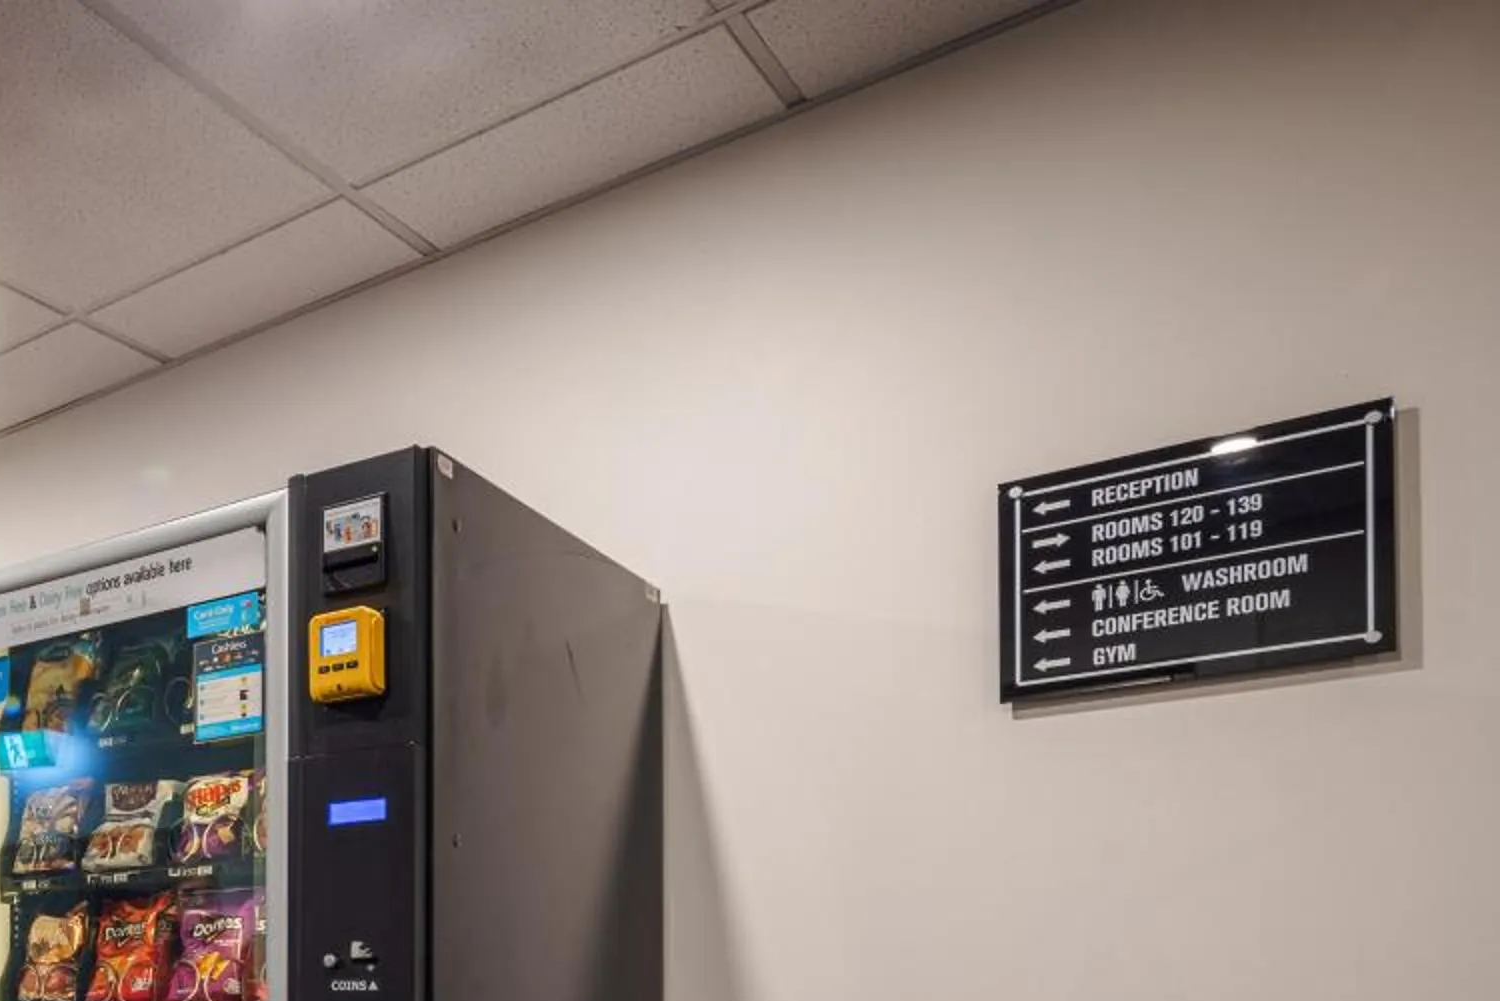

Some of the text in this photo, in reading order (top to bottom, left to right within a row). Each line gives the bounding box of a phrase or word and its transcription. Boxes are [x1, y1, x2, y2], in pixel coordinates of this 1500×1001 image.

[1091, 468, 1200, 507] RECEPTION
[1091, 512, 1164, 543] ROOMS
[1169, 505, 1205, 528] 120
[1226, 493, 1264, 517] 139
[1091, 537, 1164, 568] ROOMS
[1169, 531, 1202, 553] 101
[1226, 519, 1264, 543] 119
[85, 575, 121, 597] options
[123, 563, 165, 585] available
[169, 555, 193, 575] here
[1181, 553, 1310, 593] WASHROOM
[1091, 588, 1291, 637] CONFERENCE ROOM
[1092, 643, 1137, 666] GYM
[193, 917, 243, 937] Doritos
[331, 979, 367, 992] COINS
